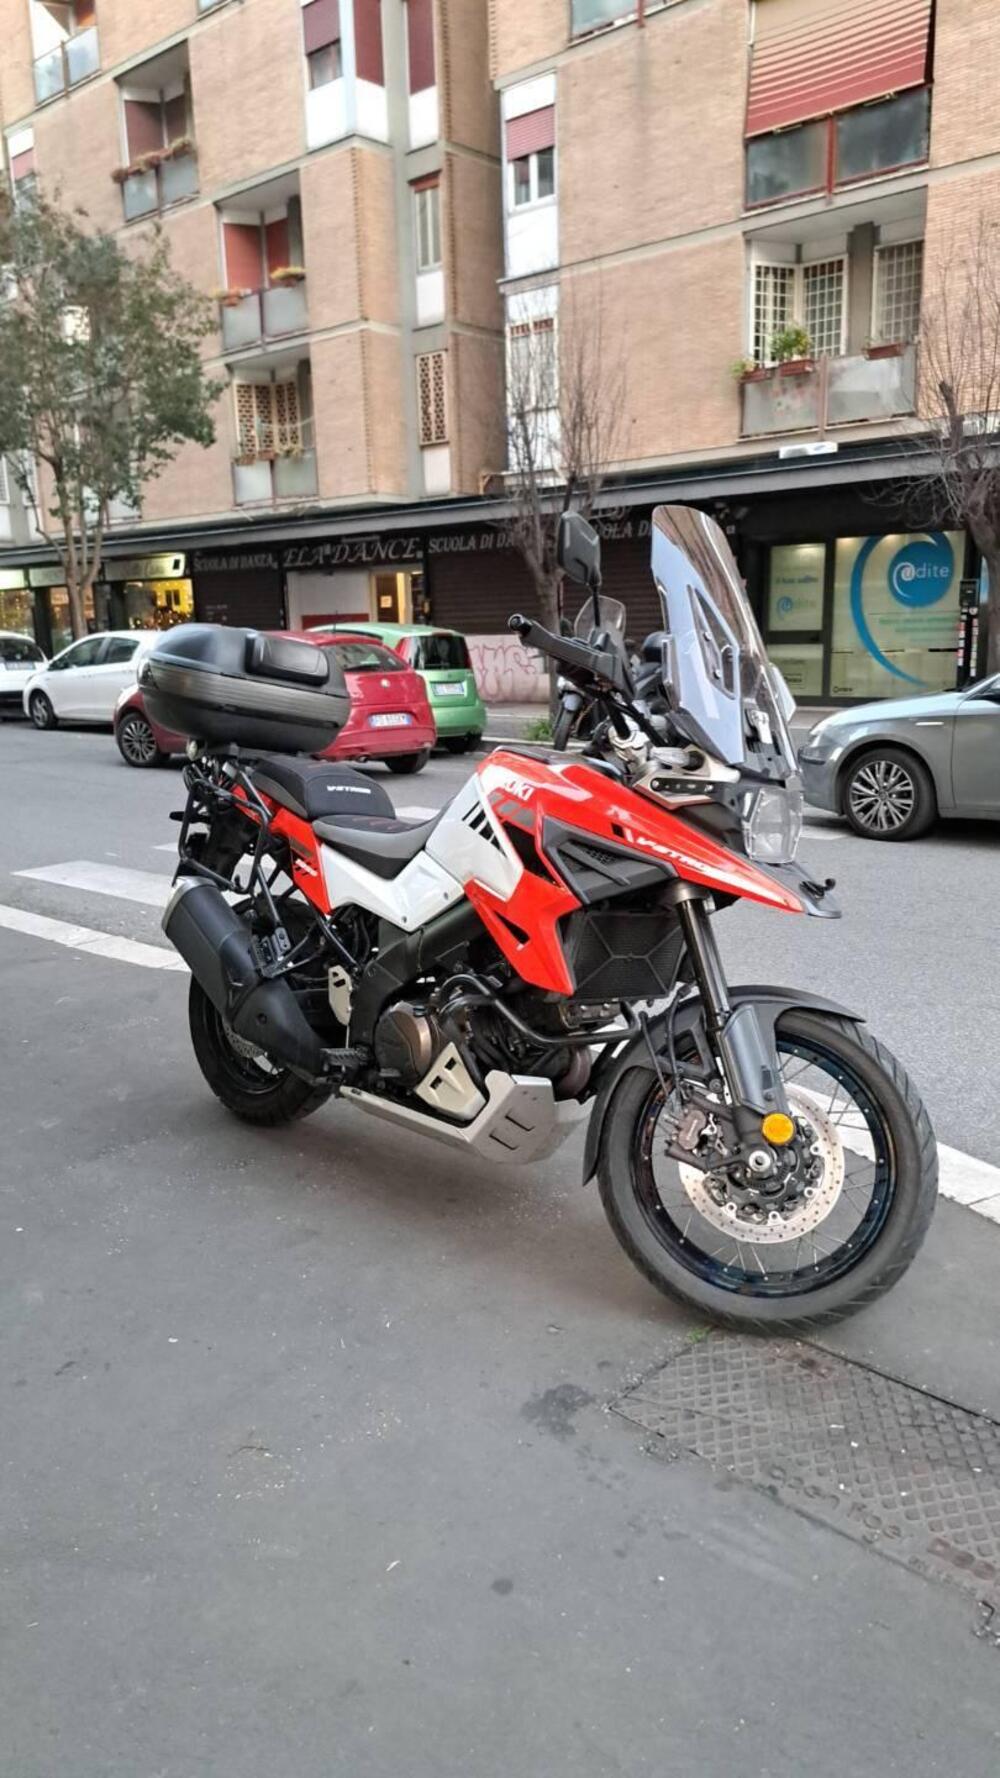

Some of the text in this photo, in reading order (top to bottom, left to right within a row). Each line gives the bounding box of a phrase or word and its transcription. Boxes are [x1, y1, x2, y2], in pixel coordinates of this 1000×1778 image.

[331, 537, 419, 564] DANCE
[428, 535, 476, 554] SCUOLA
[480, 533, 493, 549] DI
